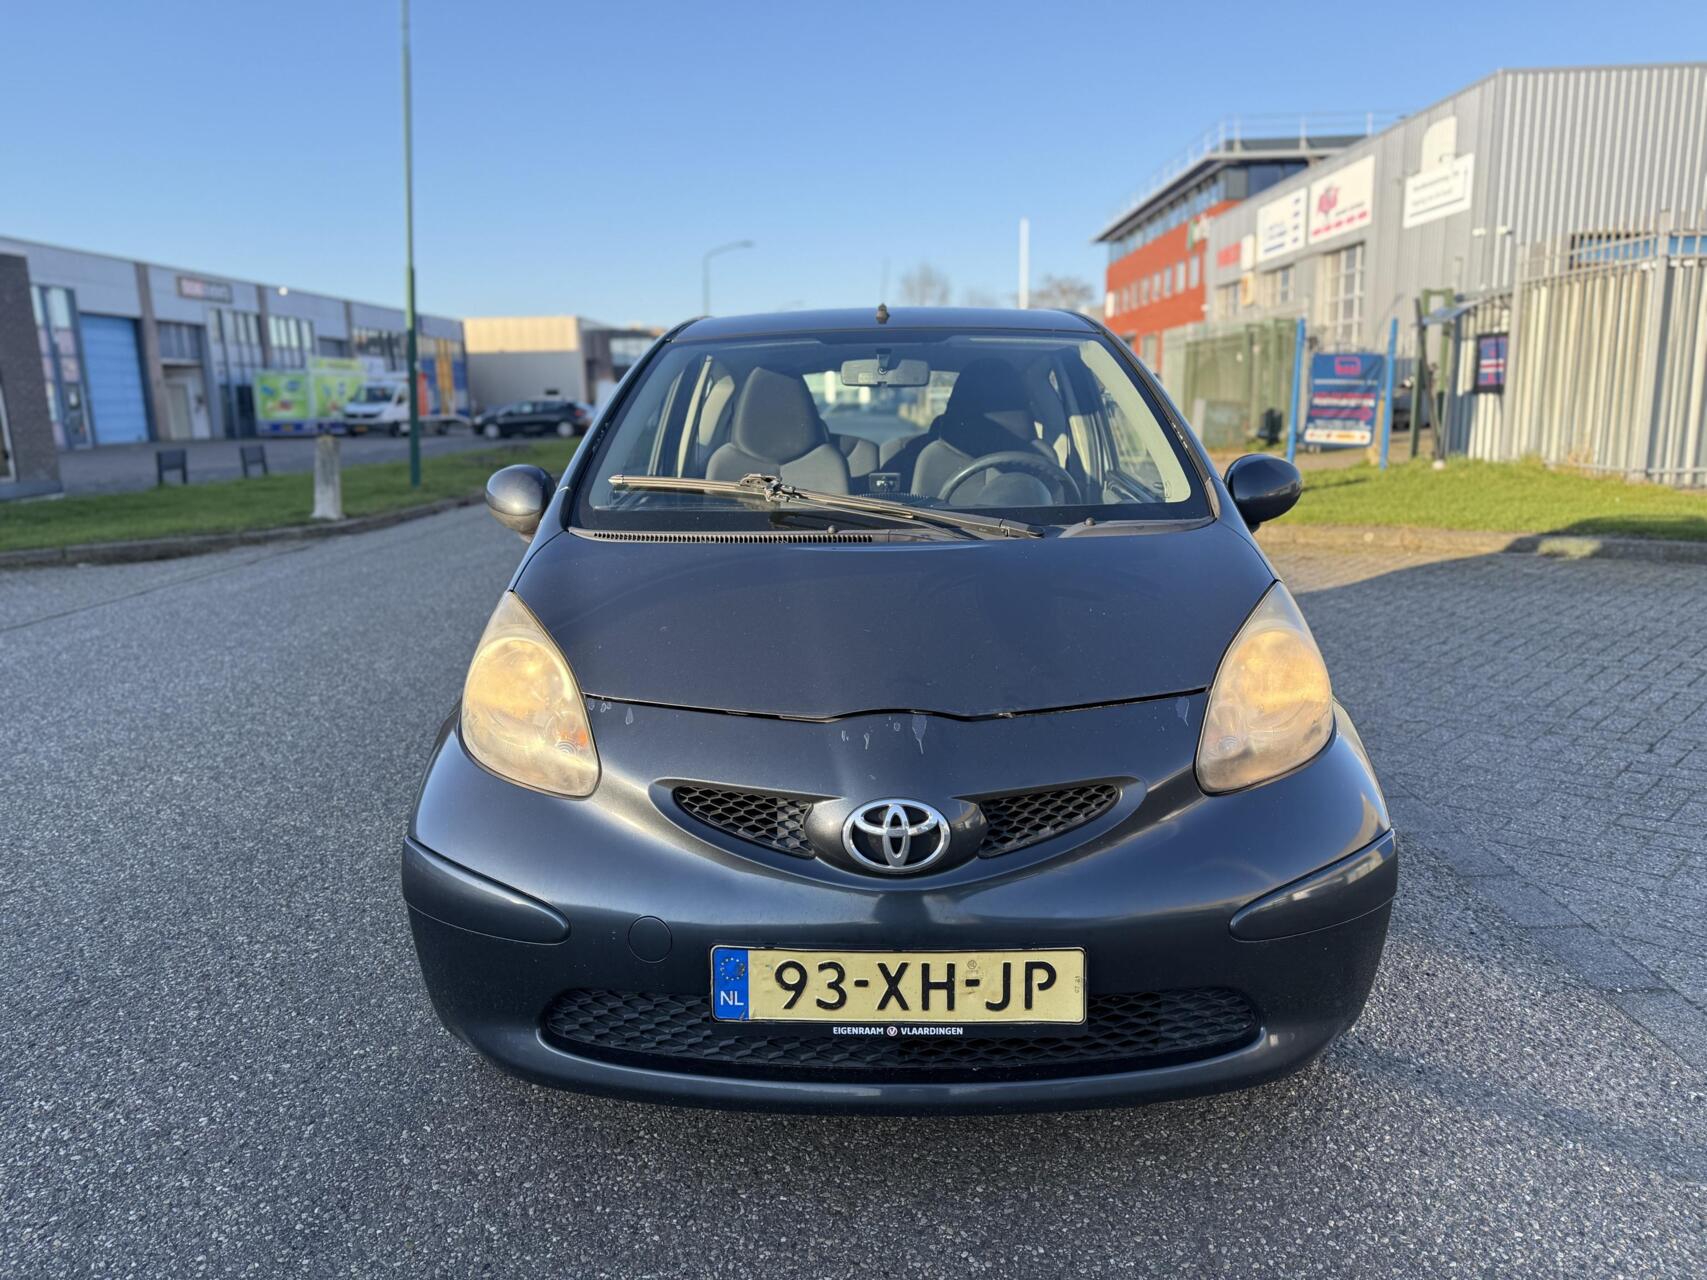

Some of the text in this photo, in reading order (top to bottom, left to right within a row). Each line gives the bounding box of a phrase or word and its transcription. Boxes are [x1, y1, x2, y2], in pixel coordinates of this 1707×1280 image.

[774, 960, 1057, 1011] 93-XH-JP
[719, 991, 744, 1006] NL
[832, 1026, 884, 1035] EIGENRAAM
[901, 1027, 963, 1035] VLAARDINGEN
